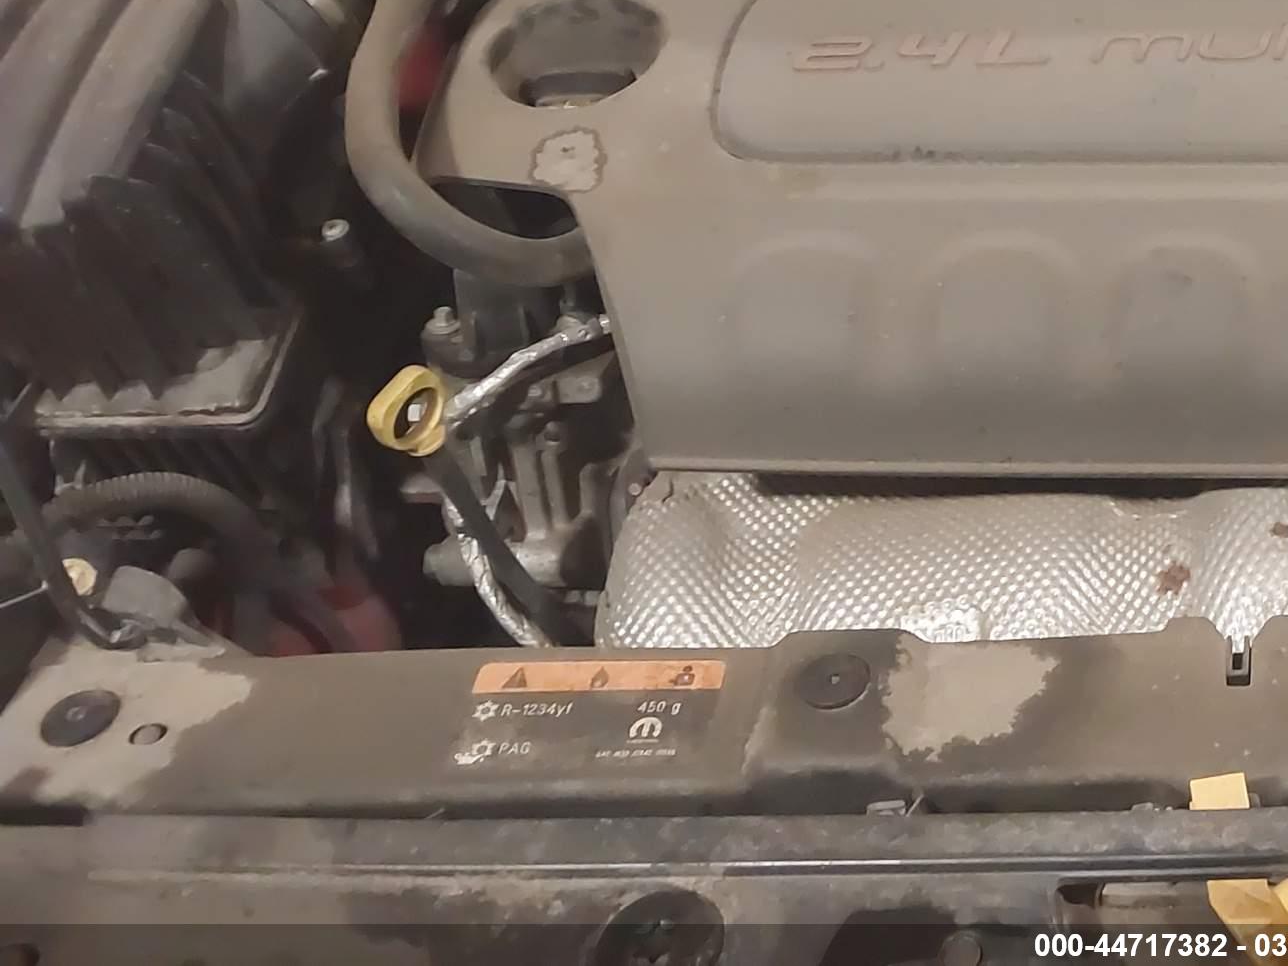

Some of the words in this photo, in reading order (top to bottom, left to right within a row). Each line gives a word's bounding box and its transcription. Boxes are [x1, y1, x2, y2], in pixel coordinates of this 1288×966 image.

[793, 29, 1050, 72] 2.4L
[501, 701, 574, 717] R-1234yf
[638, 700, 666, 713] 450
